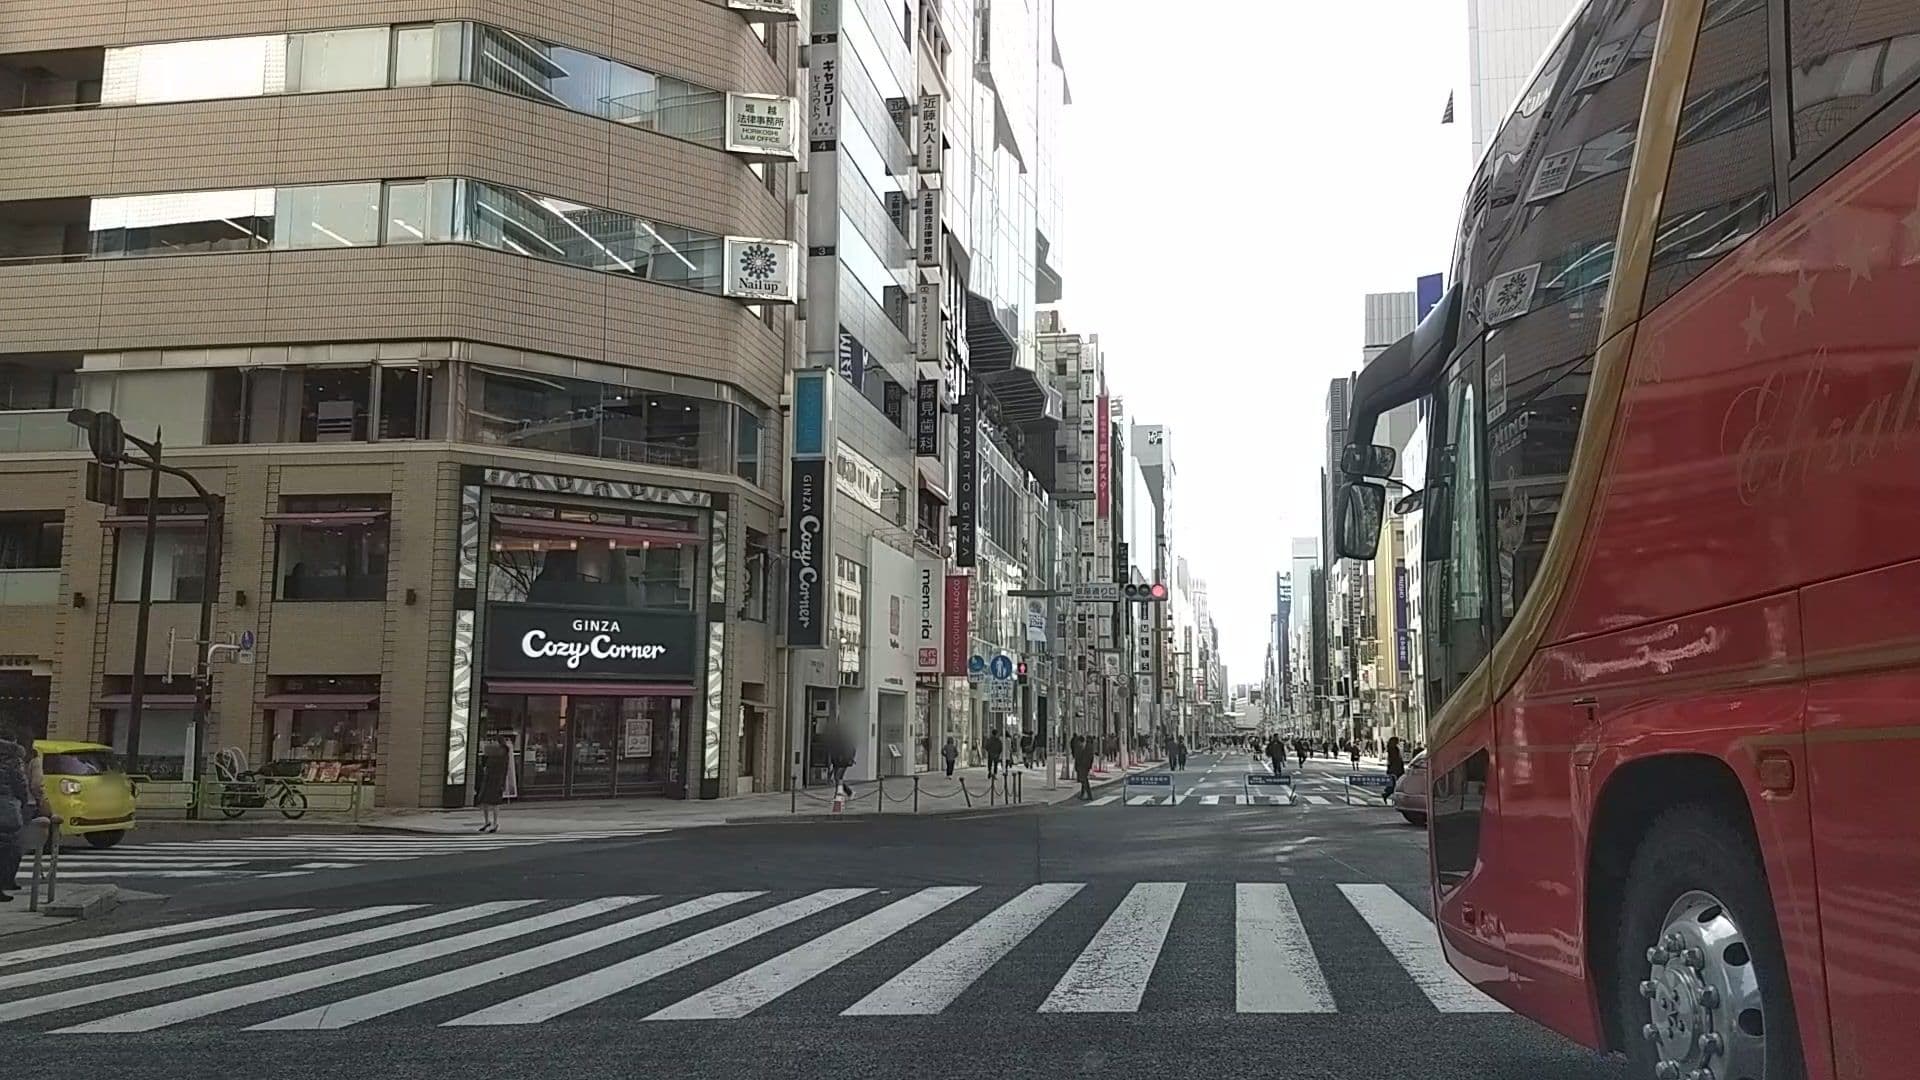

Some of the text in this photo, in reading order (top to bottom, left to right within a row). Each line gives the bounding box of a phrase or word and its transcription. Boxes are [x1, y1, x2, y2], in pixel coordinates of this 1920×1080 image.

[821, 33, 829, 44] 5
[823, 60, 834, 116] ギャラリー
[737, 113, 785, 127] 法律事務所
[740, 133, 780, 144] LAW OFFICE
[742, 127, 779, 137] HORIKOSHI
[923, 97, 937, 145] 近藤丸人
[739, 278, 763, 291] Nail
[963, 403, 971, 493] KIRARITO
[962, 502, 971, 556] GINZA
[792, 474, 821, 629] GINZA Cozy Corner
[921, 569, 932, 640] memoria
[572, 619, 621, 633] GINZA
[521, 629, 666, 669] Cozy Corner
